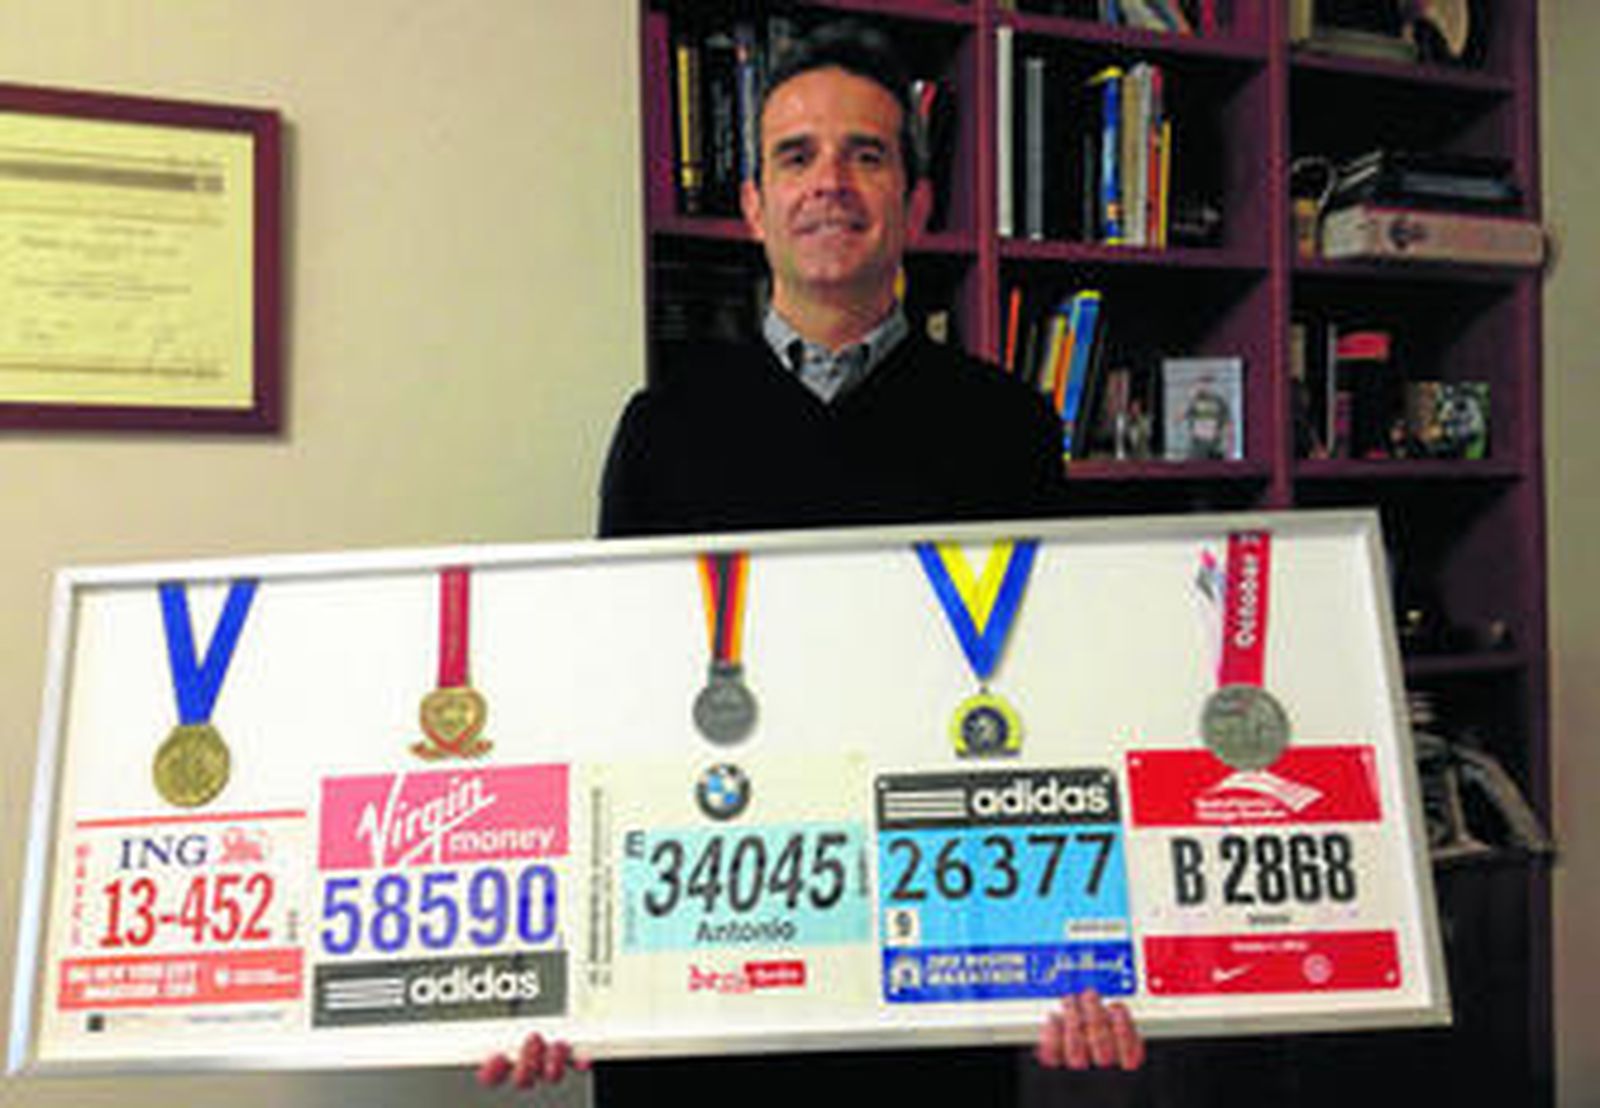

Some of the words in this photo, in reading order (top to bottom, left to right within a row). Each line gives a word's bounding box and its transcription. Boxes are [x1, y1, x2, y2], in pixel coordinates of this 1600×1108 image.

[357, 773, 496, 868] Virgin
[972, 777, 1109, 815] adidas
[120, 834, 209, 870] ING
[450, 826, 555, 853] money
[625, 829, 645, 860] E
[643, 831, 848, 919] 34045
[888, 831, 1115, 901] 26377
[1171, 836, 1206, 906] B
[1219, 832, 1357, 906] 2868
[99, 872, 274, 948] 13-452
[321, 864, 558, 955] 58590
[695, 917, 797, 943] Antonio
[409, 965, 540, 1005] adidas
